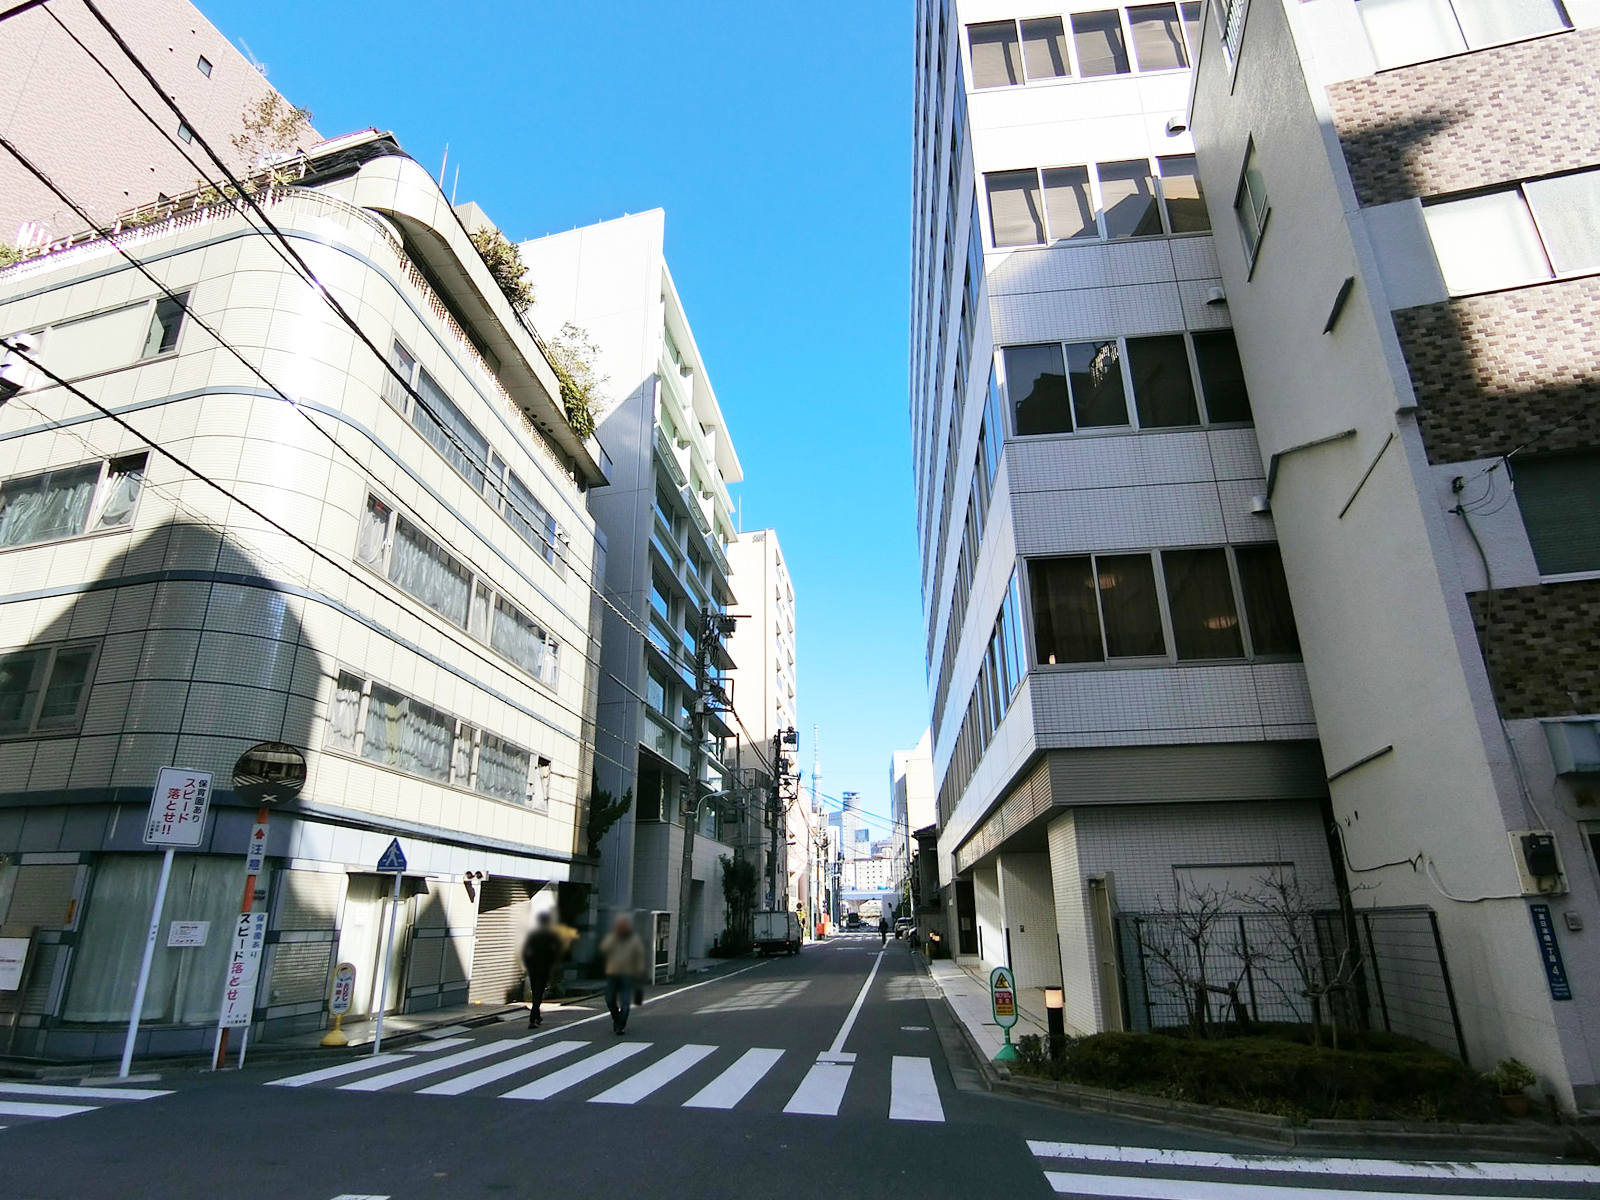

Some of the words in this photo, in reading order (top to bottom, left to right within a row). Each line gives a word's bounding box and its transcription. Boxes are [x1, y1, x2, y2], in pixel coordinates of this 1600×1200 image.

[178, 777, 196, 824] スピード
[192, 779, 209, 823] 保育園あり
[248, 843, 263, 870] 注意
[1552, 965, 1560, 976] 4
